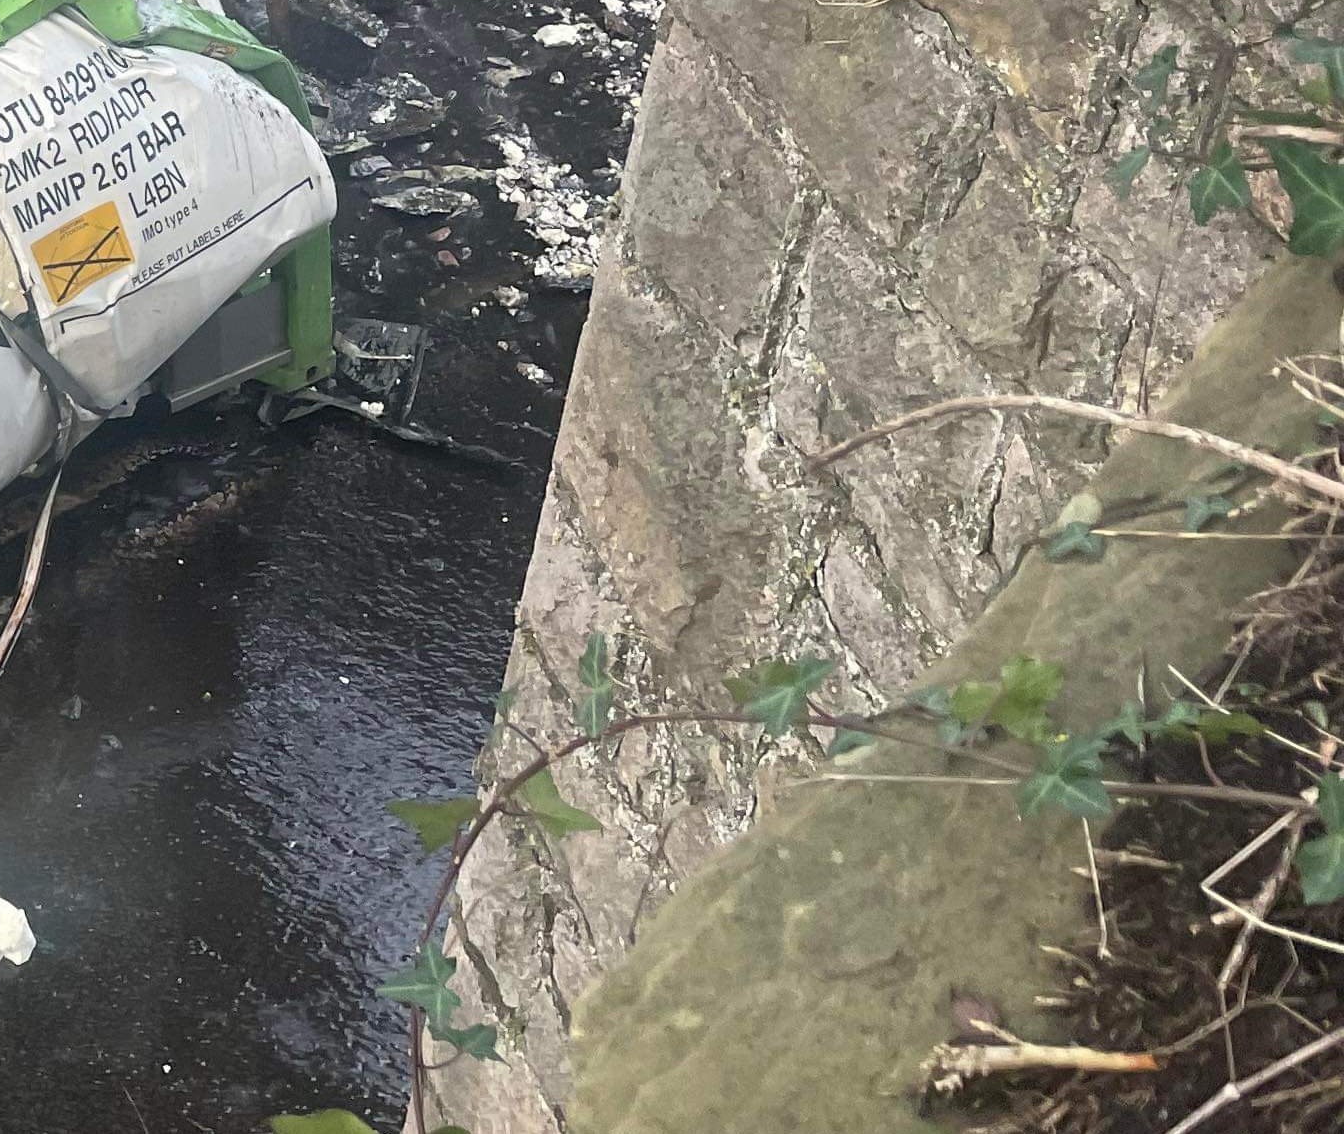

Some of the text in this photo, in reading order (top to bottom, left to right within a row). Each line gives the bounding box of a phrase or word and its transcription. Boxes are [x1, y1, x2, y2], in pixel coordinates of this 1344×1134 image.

[68, 76, 156, 154] RID/ADR
[12, 172, 86, 233] MAWP
[92, 142, 136, 191] 2.67
[137, 110, 187, 162] BAR
[128, 160, 187, 219] L4BN
[131, 209, 246, 288] PLEASE PUT LABELS HERE
[141, 197, 199, 243] IMO type 4
